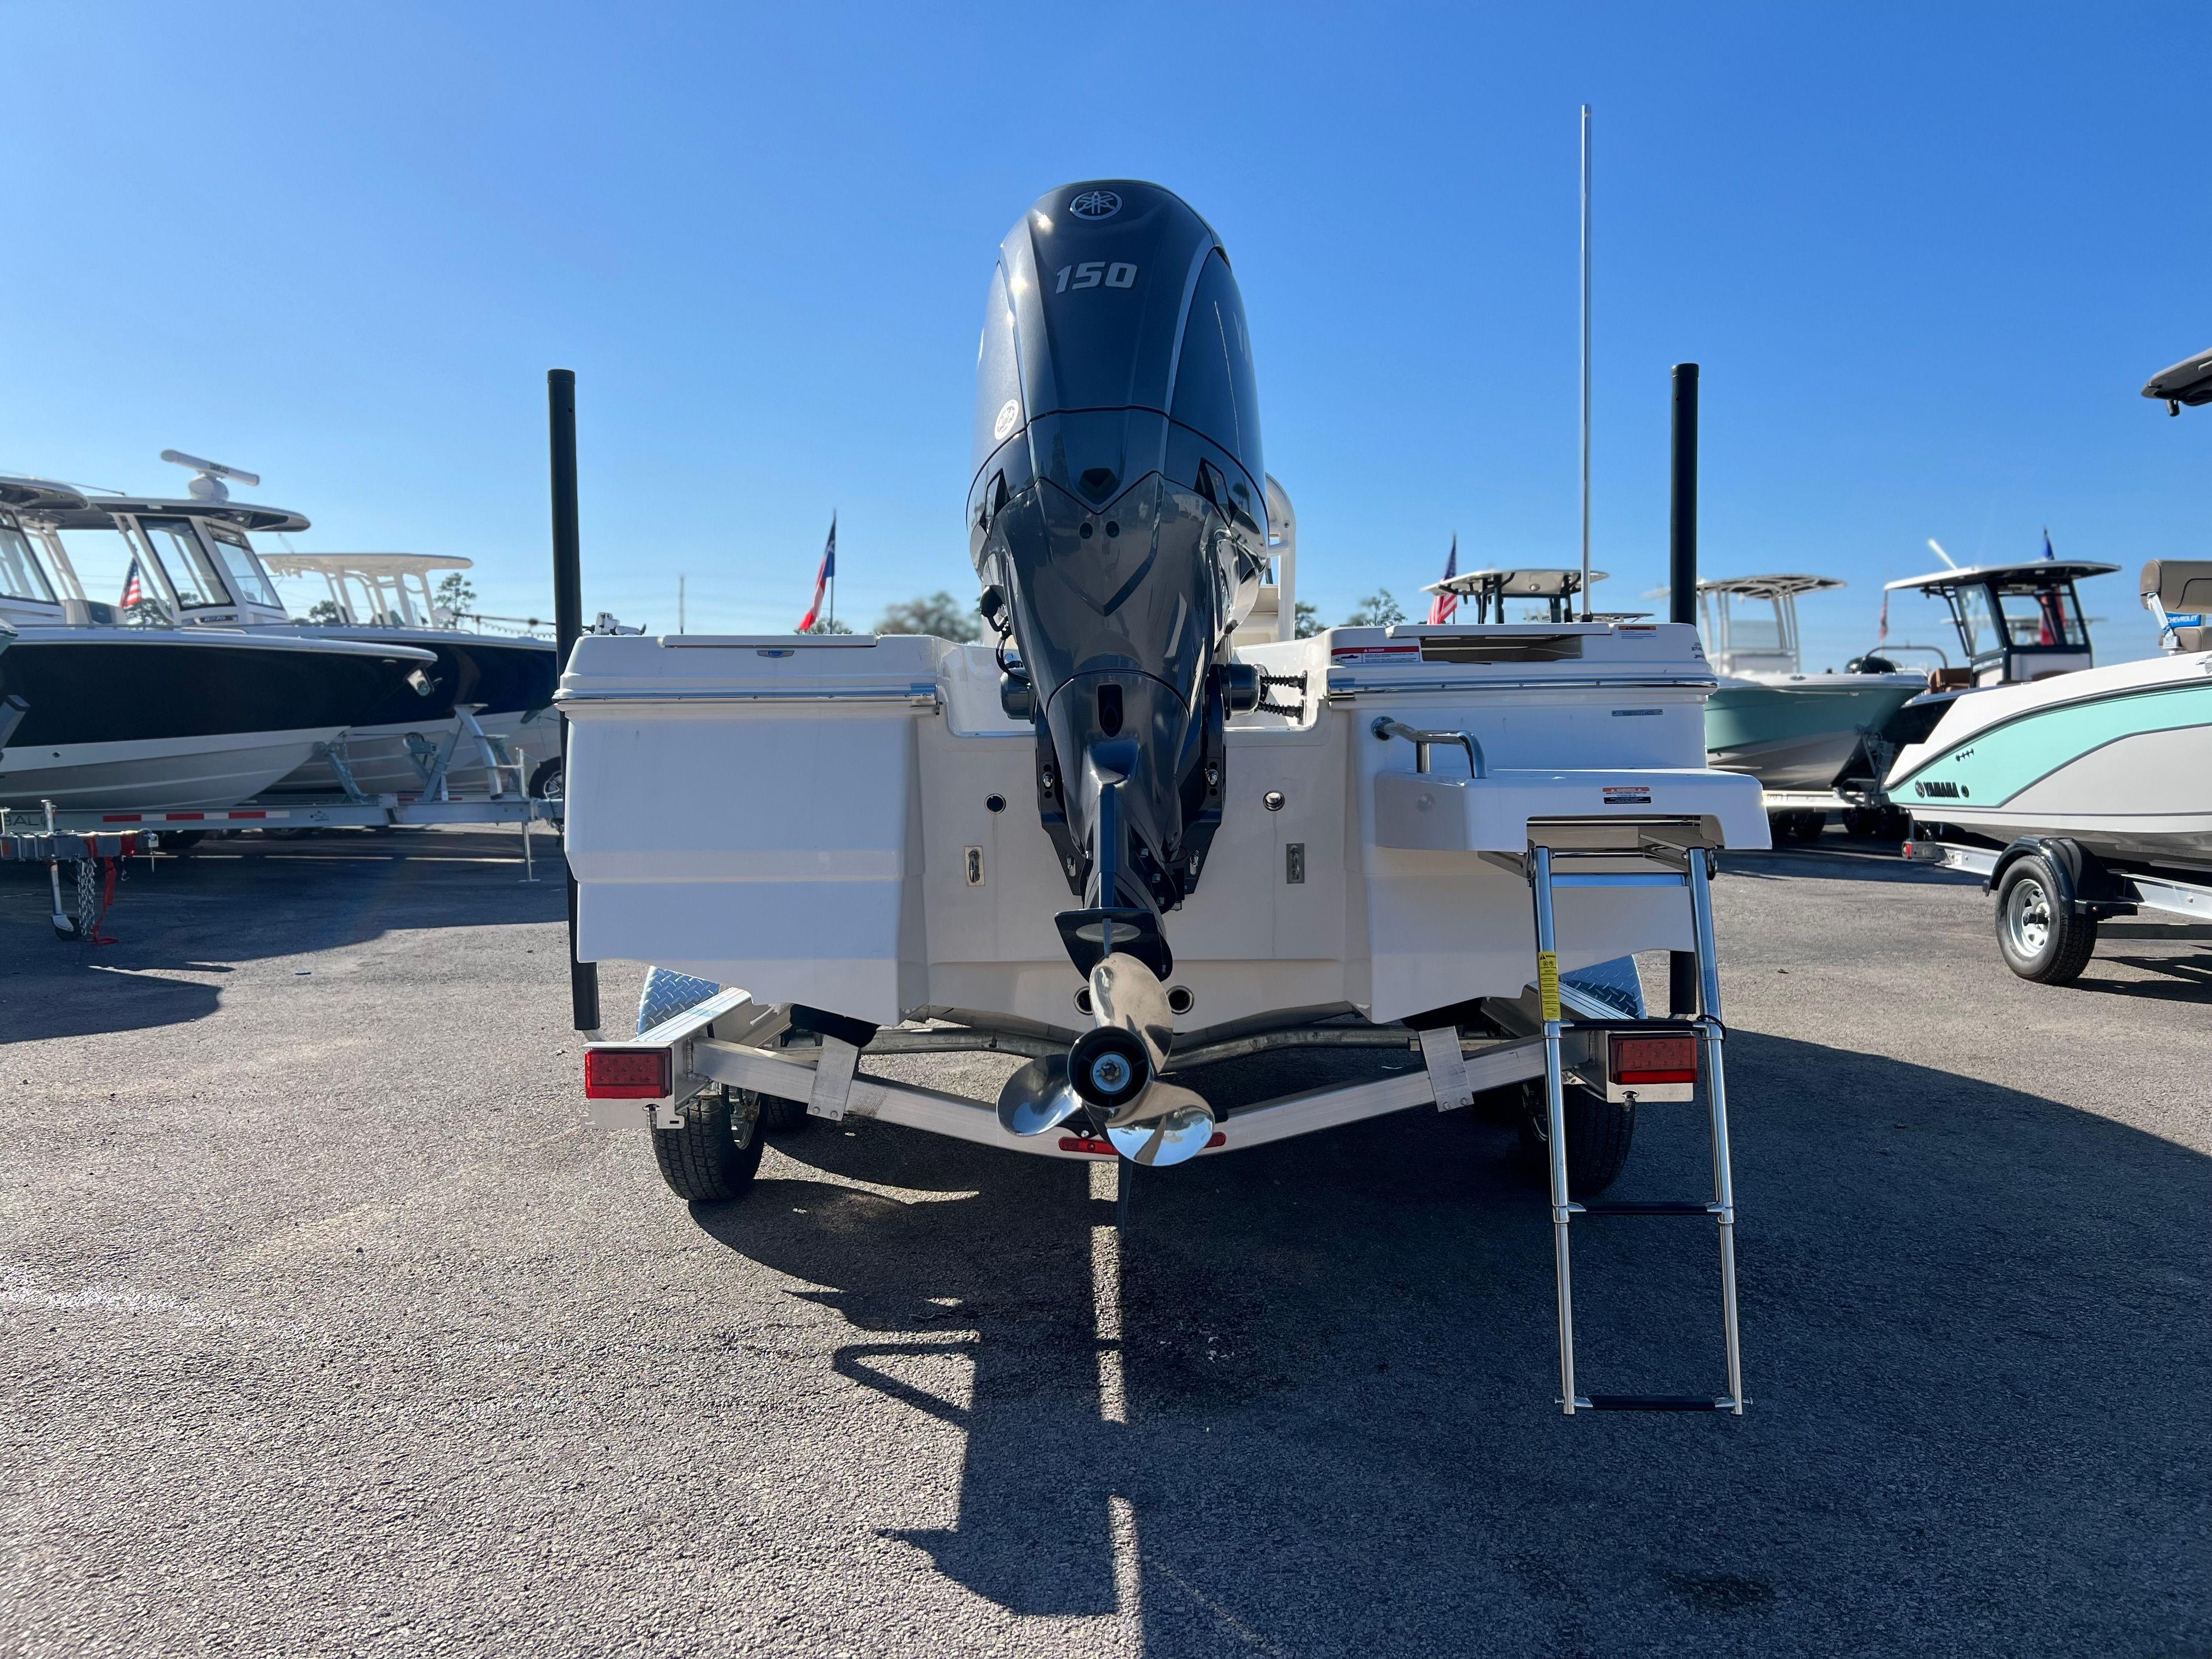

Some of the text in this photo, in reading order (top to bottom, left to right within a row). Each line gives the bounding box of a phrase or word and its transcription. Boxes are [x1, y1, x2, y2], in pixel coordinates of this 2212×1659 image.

[1055, 261, 1138, 295] 150
[210, 462, 229, 474] SIMRAD
[2167, 614, 2198, 623] CHEVROLET
[1922, 781, 1960, 799] YAMAHA
[5, 815, 46, 826] BAL
